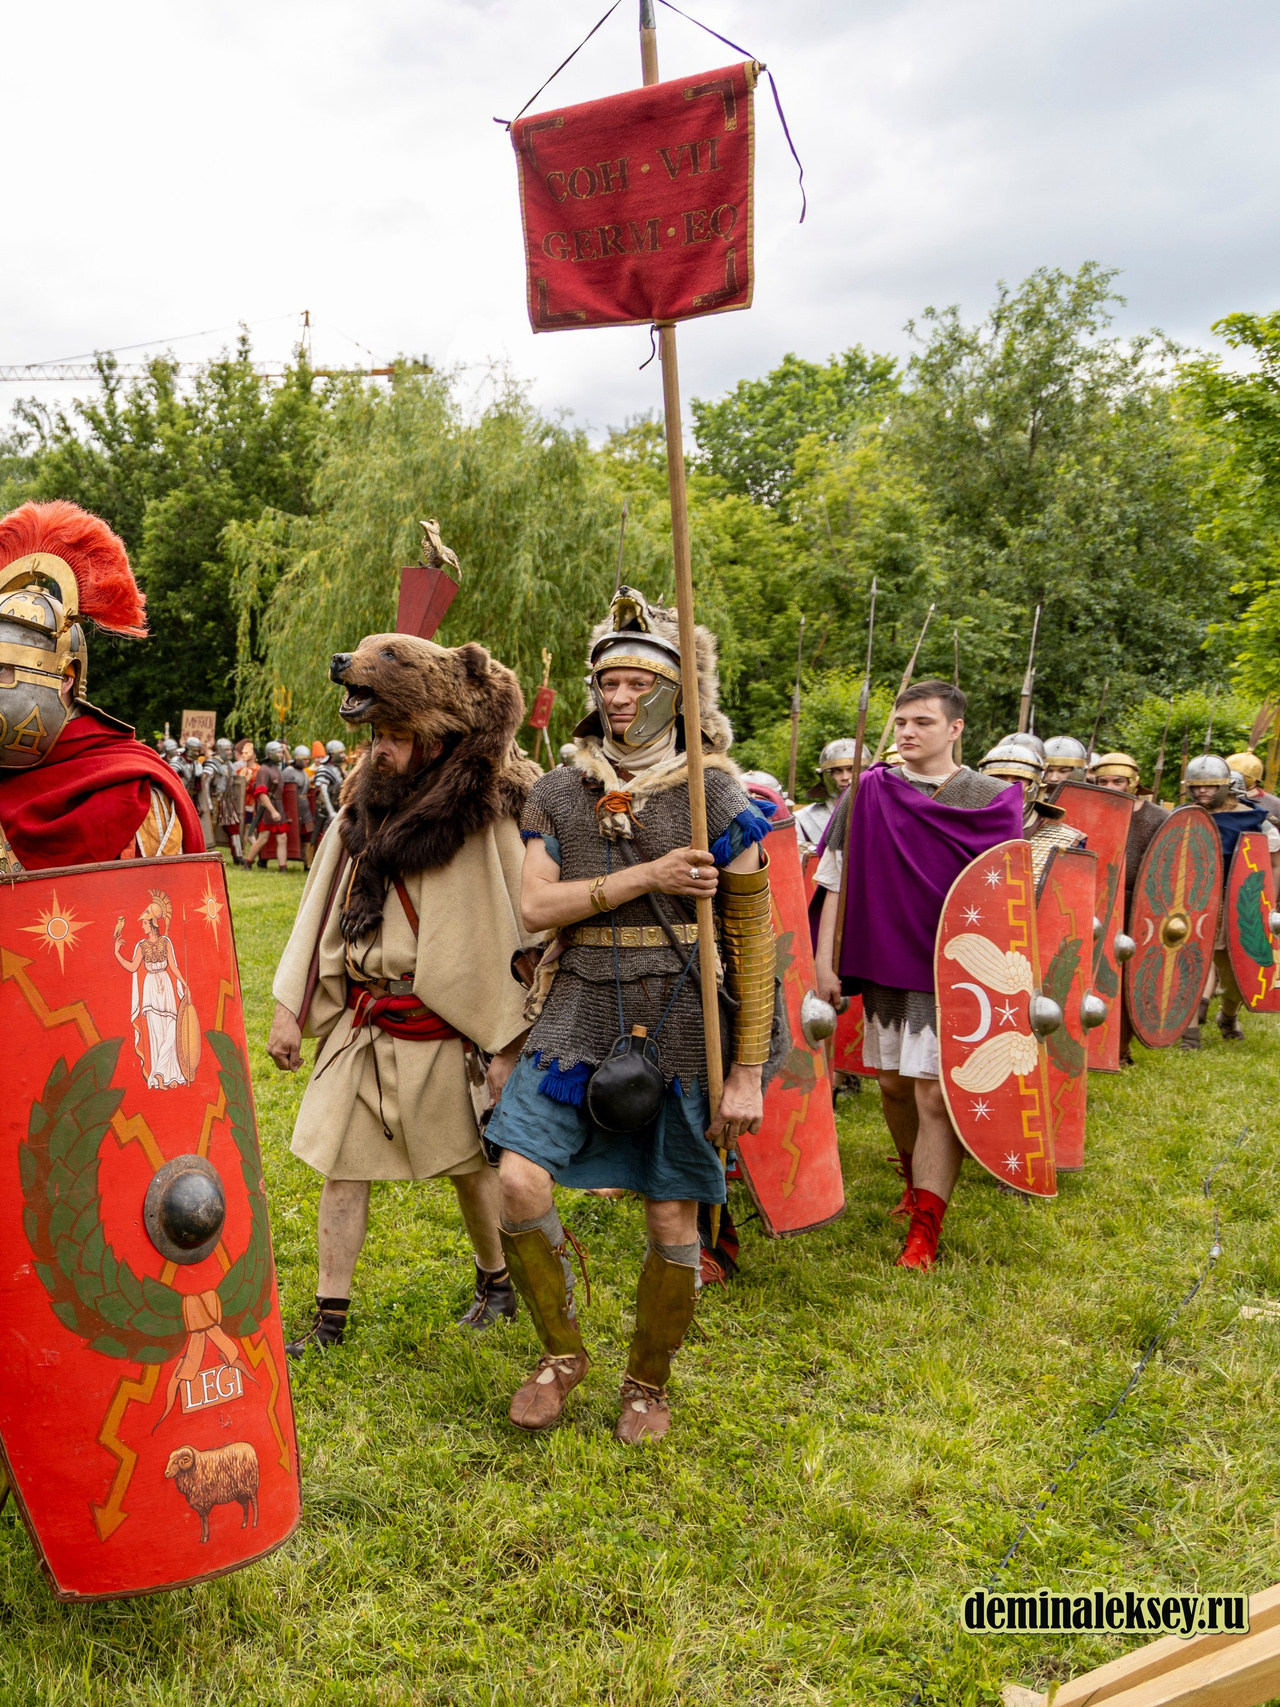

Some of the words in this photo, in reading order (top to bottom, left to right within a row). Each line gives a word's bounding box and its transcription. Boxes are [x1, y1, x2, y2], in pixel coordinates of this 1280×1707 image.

[545, 158, 630, 202] COH
[656, 137, 724, 180] VII
[542, 217, 662, 263] GERM
[682, 204, 739, 245] EQ
